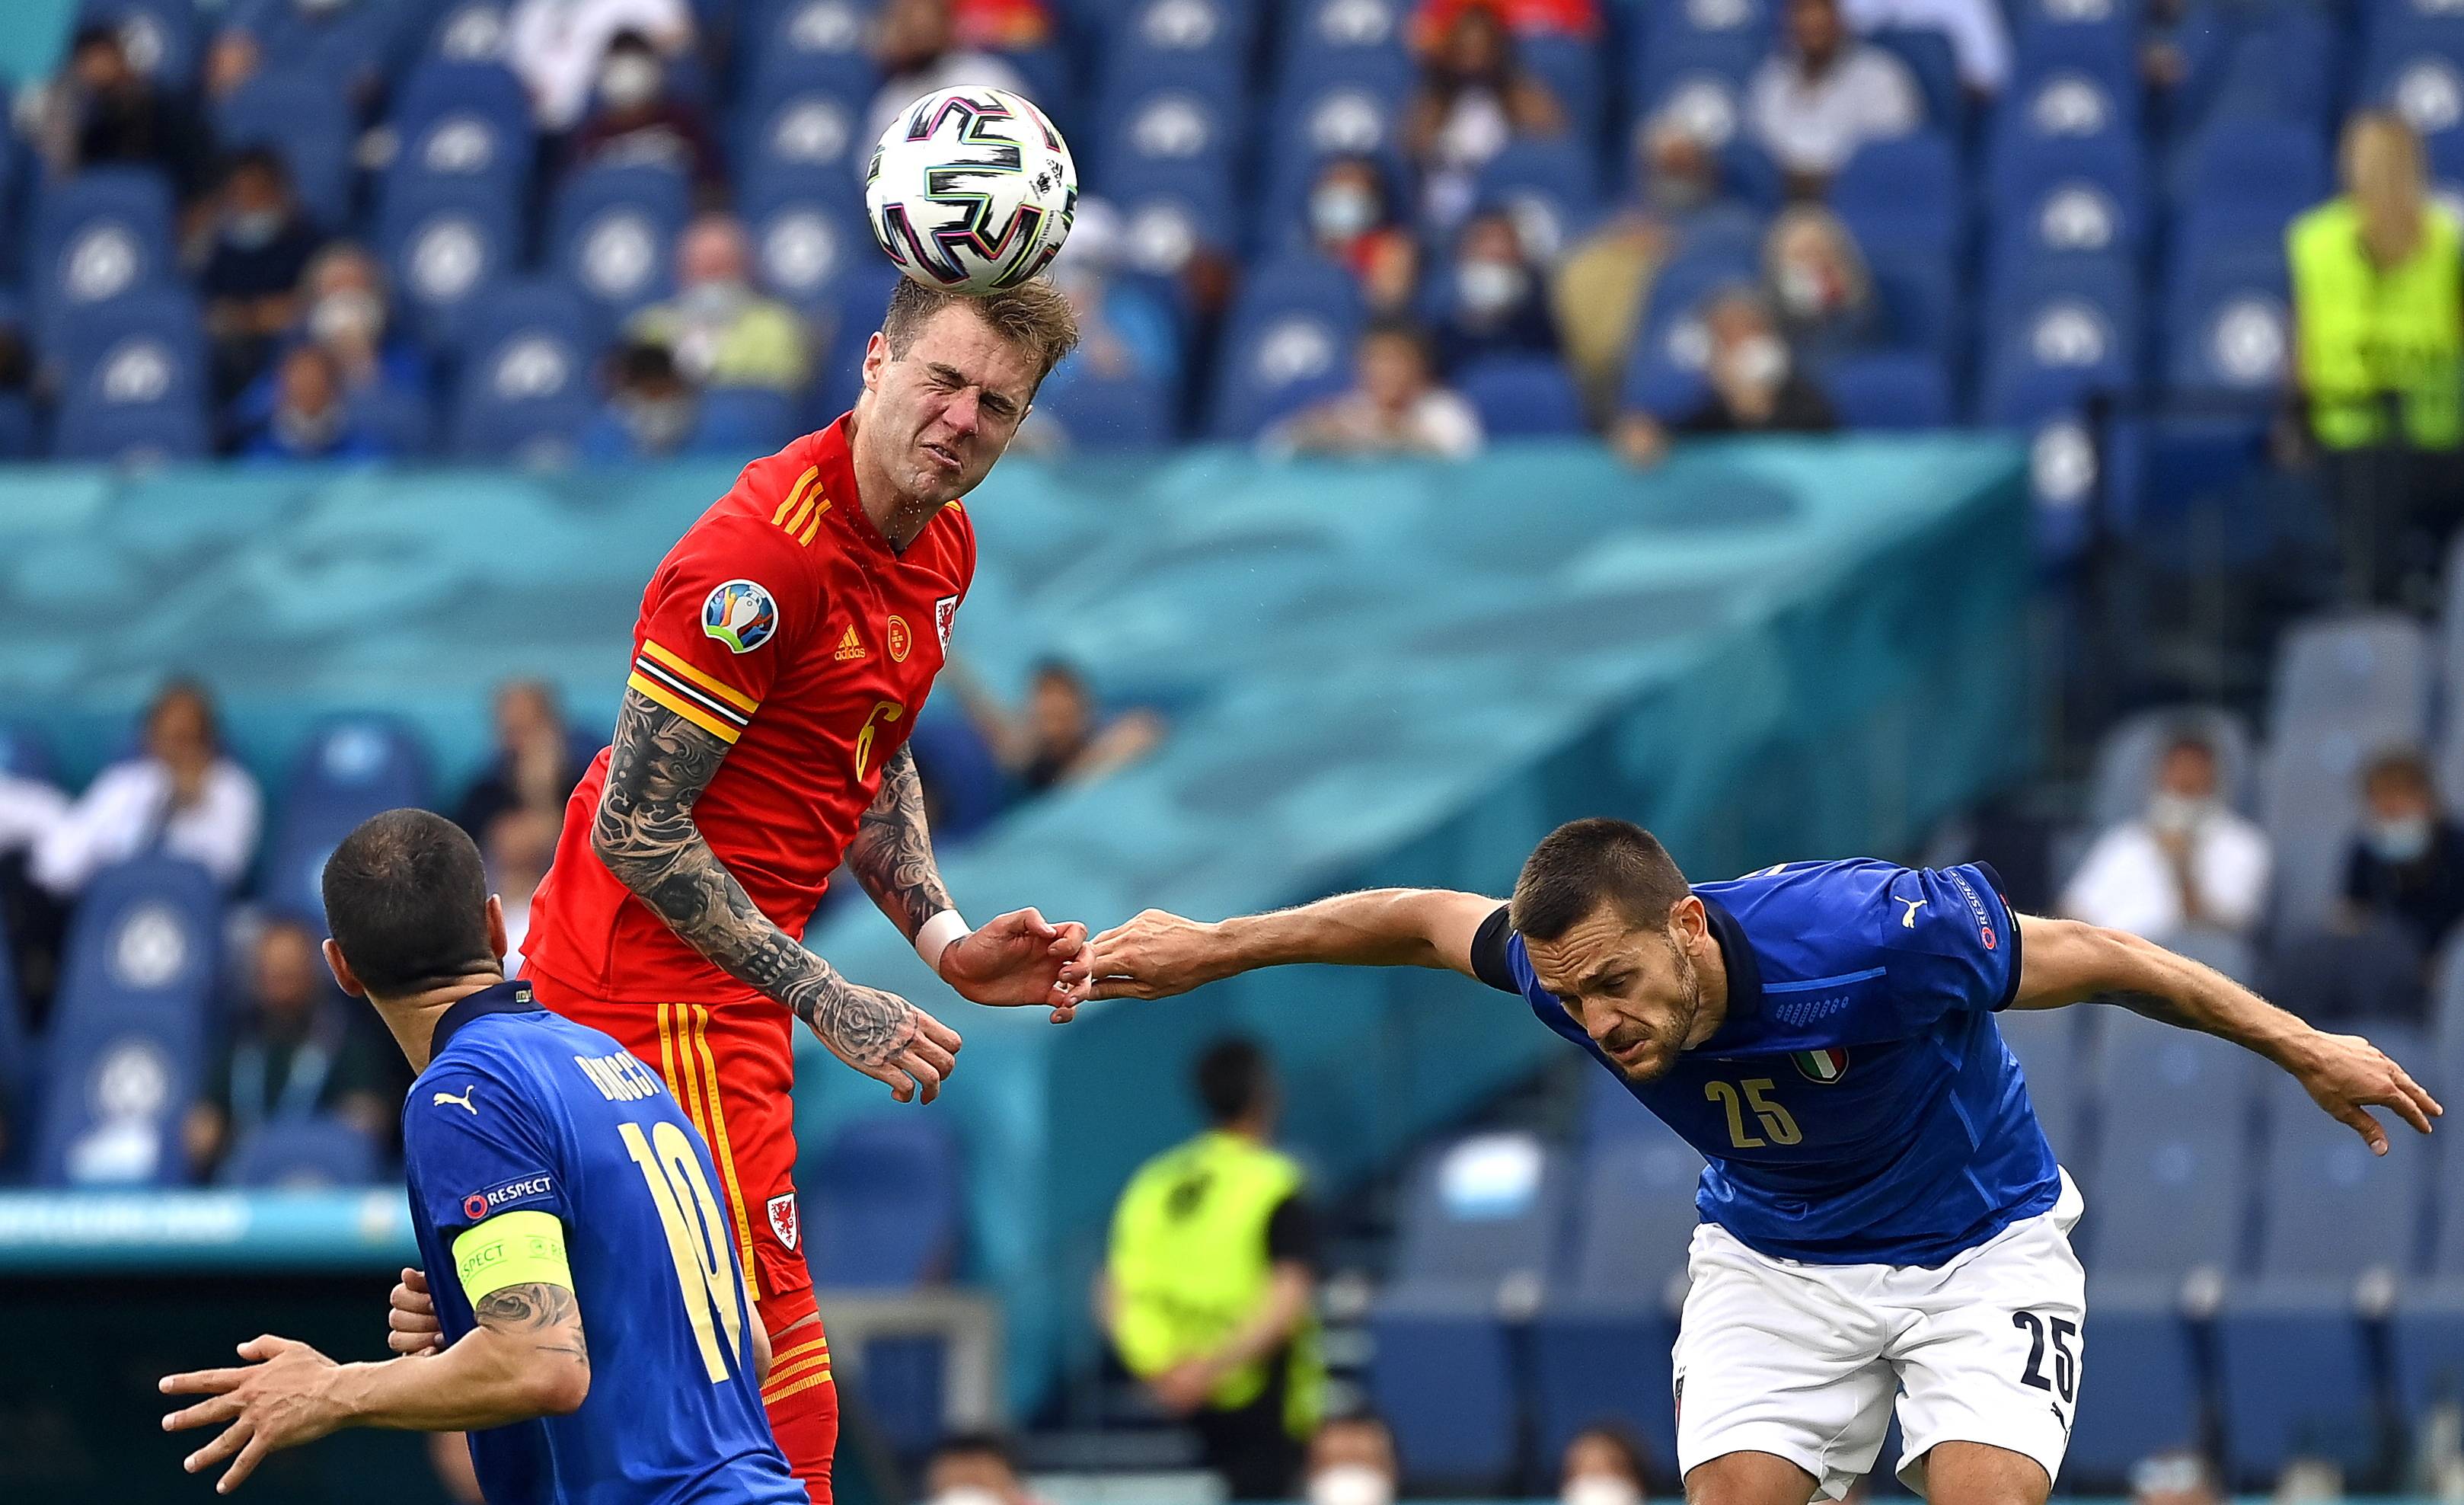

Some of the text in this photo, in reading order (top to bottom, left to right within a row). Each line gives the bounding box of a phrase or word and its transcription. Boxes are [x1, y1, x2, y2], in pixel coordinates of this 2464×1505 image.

[835, 647, 866, 661] adidas
[856, 701, 903, 783] 6
[1949, 870, 1988, 925] RESPECT
[1705, 1078, 1802, 1148] 25
[487, 1177, 551, 1206] RESPECT
[618, 1121, 741, 1384] 10
[2012, 1311, 2076, 1404] 25
